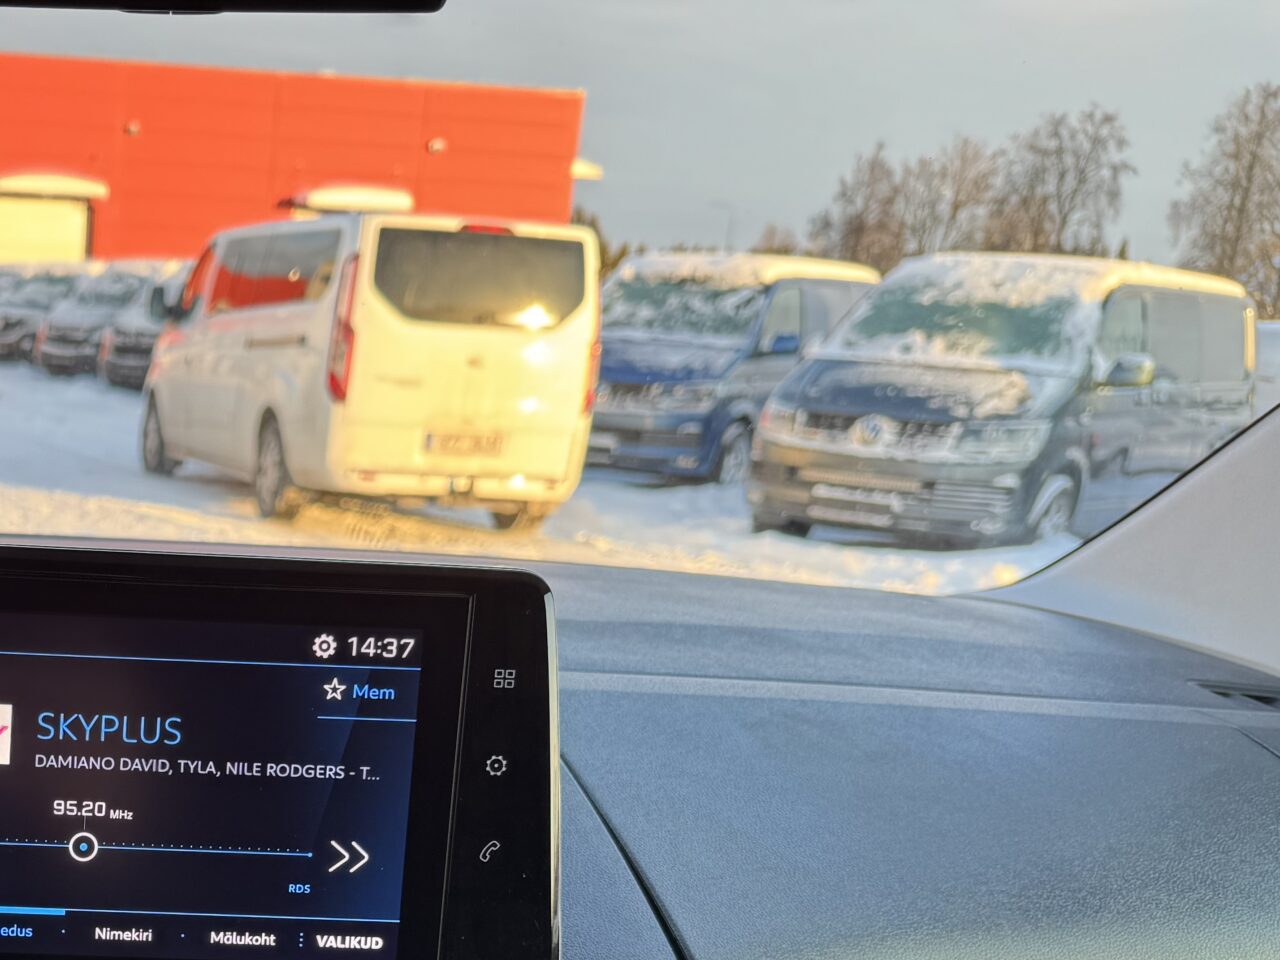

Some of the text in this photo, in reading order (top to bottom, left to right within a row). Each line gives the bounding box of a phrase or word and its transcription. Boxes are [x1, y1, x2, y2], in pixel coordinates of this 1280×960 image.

[347, 637, 416, 658] 14:37
[352, 684, 395, 700] Mem
[36, 712, 182, 745] SKYPLUS
[35, 754, 115, 771] DAMIANO
[120, 757, 173, 776] DAVID,
[177, 760, 221, 777] TYLA,
[226, 761, 262, 777] NILE
[266, 763, 345, 780] RODGERS
[53, 800, 134, 821] 95.20 MHz
[288, 884, 311, 894] RDS
[94, 927, 153, 942] Nimekiri
[210, 930, 277, 946] Mälukoht
[316, 934, 384, 950] VALIKUD
